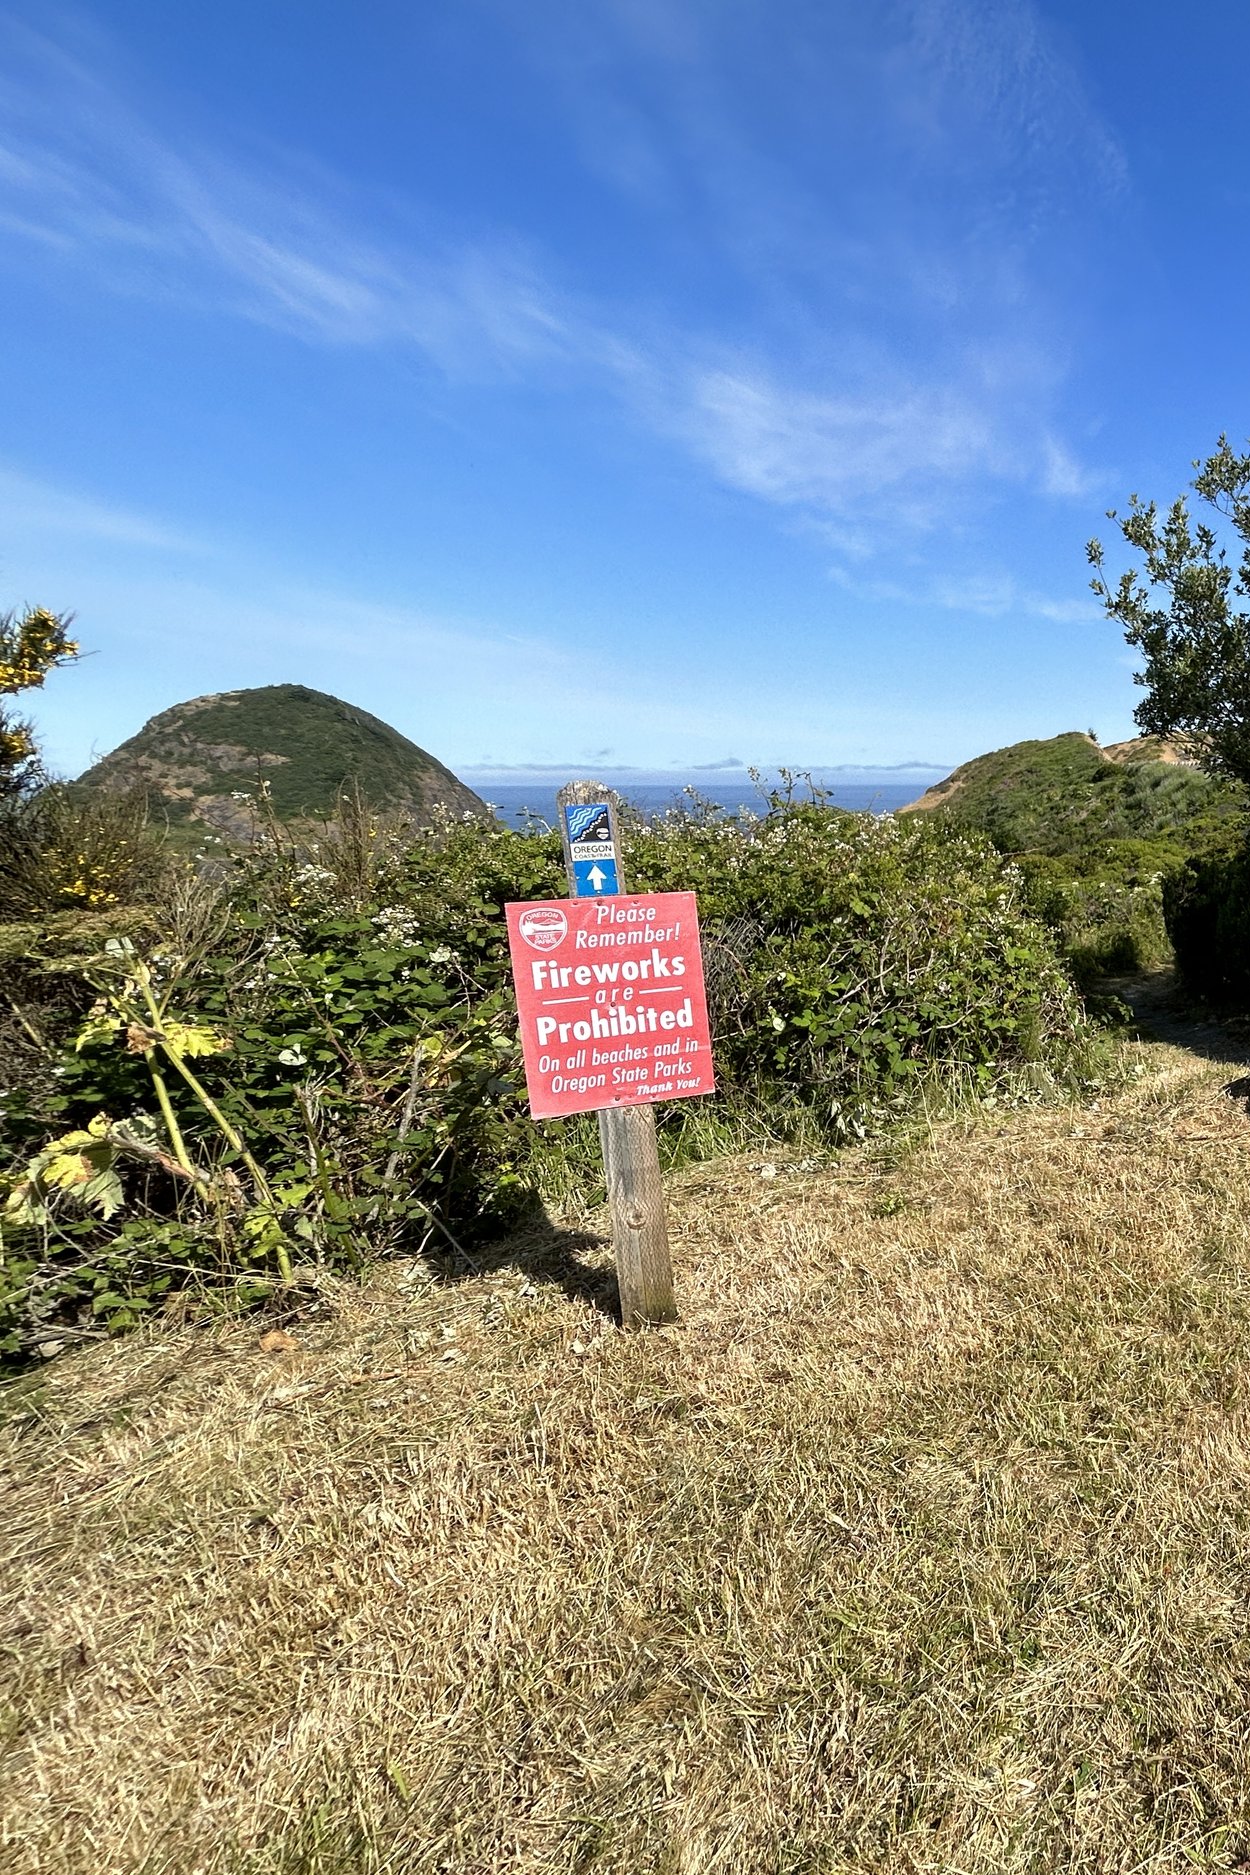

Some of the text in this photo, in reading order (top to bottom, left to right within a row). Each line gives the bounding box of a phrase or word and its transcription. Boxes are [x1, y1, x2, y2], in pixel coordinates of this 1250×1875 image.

[573, 845, 612, 853] OREGON
[526, 911, 559, 921] OREGON
[597, 904, 657, 925] Please
[575, 922, 681, 949] Remember!
[531, 948, 686, 990] Fireworks
[595, 986, 634, 1004] are
[536, 998, 694, 1046] Prohibited
[538, 1037, 698, 1073] On all beaches and in
[551, 1057, 692, 1094] Oregon State Parks
[636, 1076, 701, 1096] Thank You!
